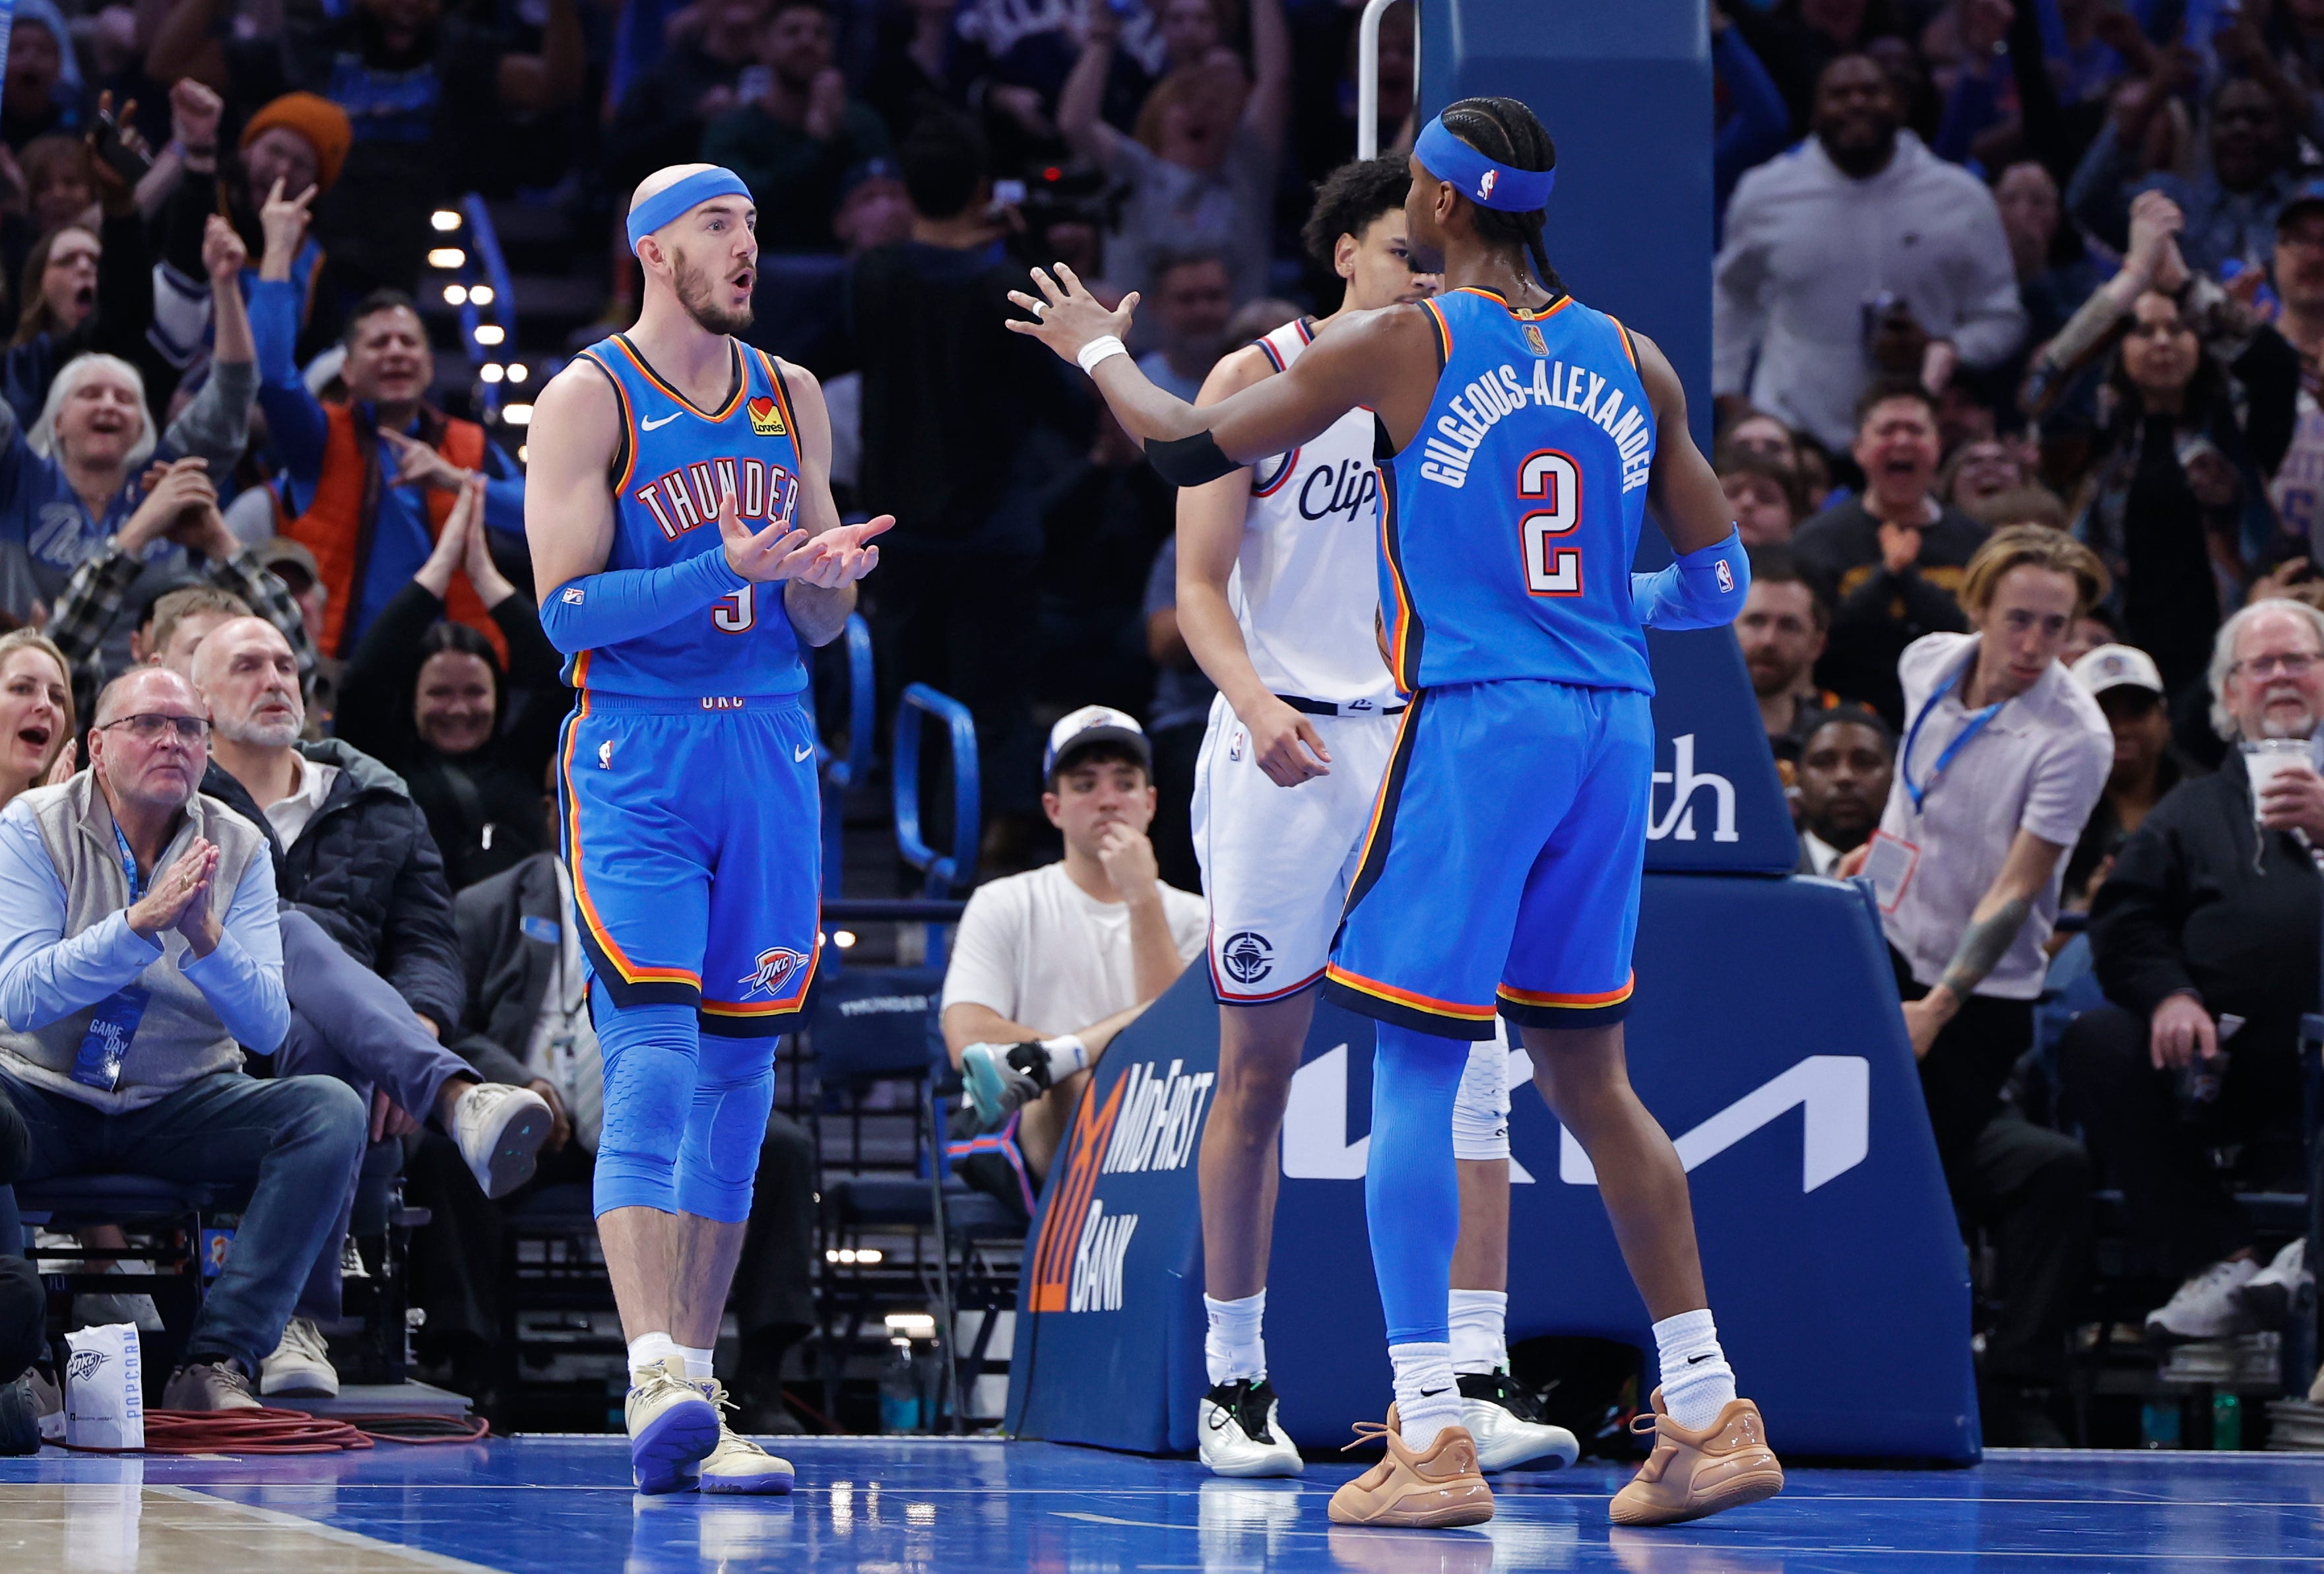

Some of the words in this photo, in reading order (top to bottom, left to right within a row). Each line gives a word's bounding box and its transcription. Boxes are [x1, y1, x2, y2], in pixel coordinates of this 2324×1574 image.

[1421, 358, 1650, 495] GILGEOUS-ALEXANDER
[635, 458, 799, 541] THUNDER
[1299, 458, 1376, 523] Clip
[1517, 448, 1583, 597] 2
[755, 956, 789, 988] OKC
[90, 1019, 124, 1039] GAME
[104, 1037, 128, 1055] DAY
[123, 1331, 142, 1420] POPCORN
